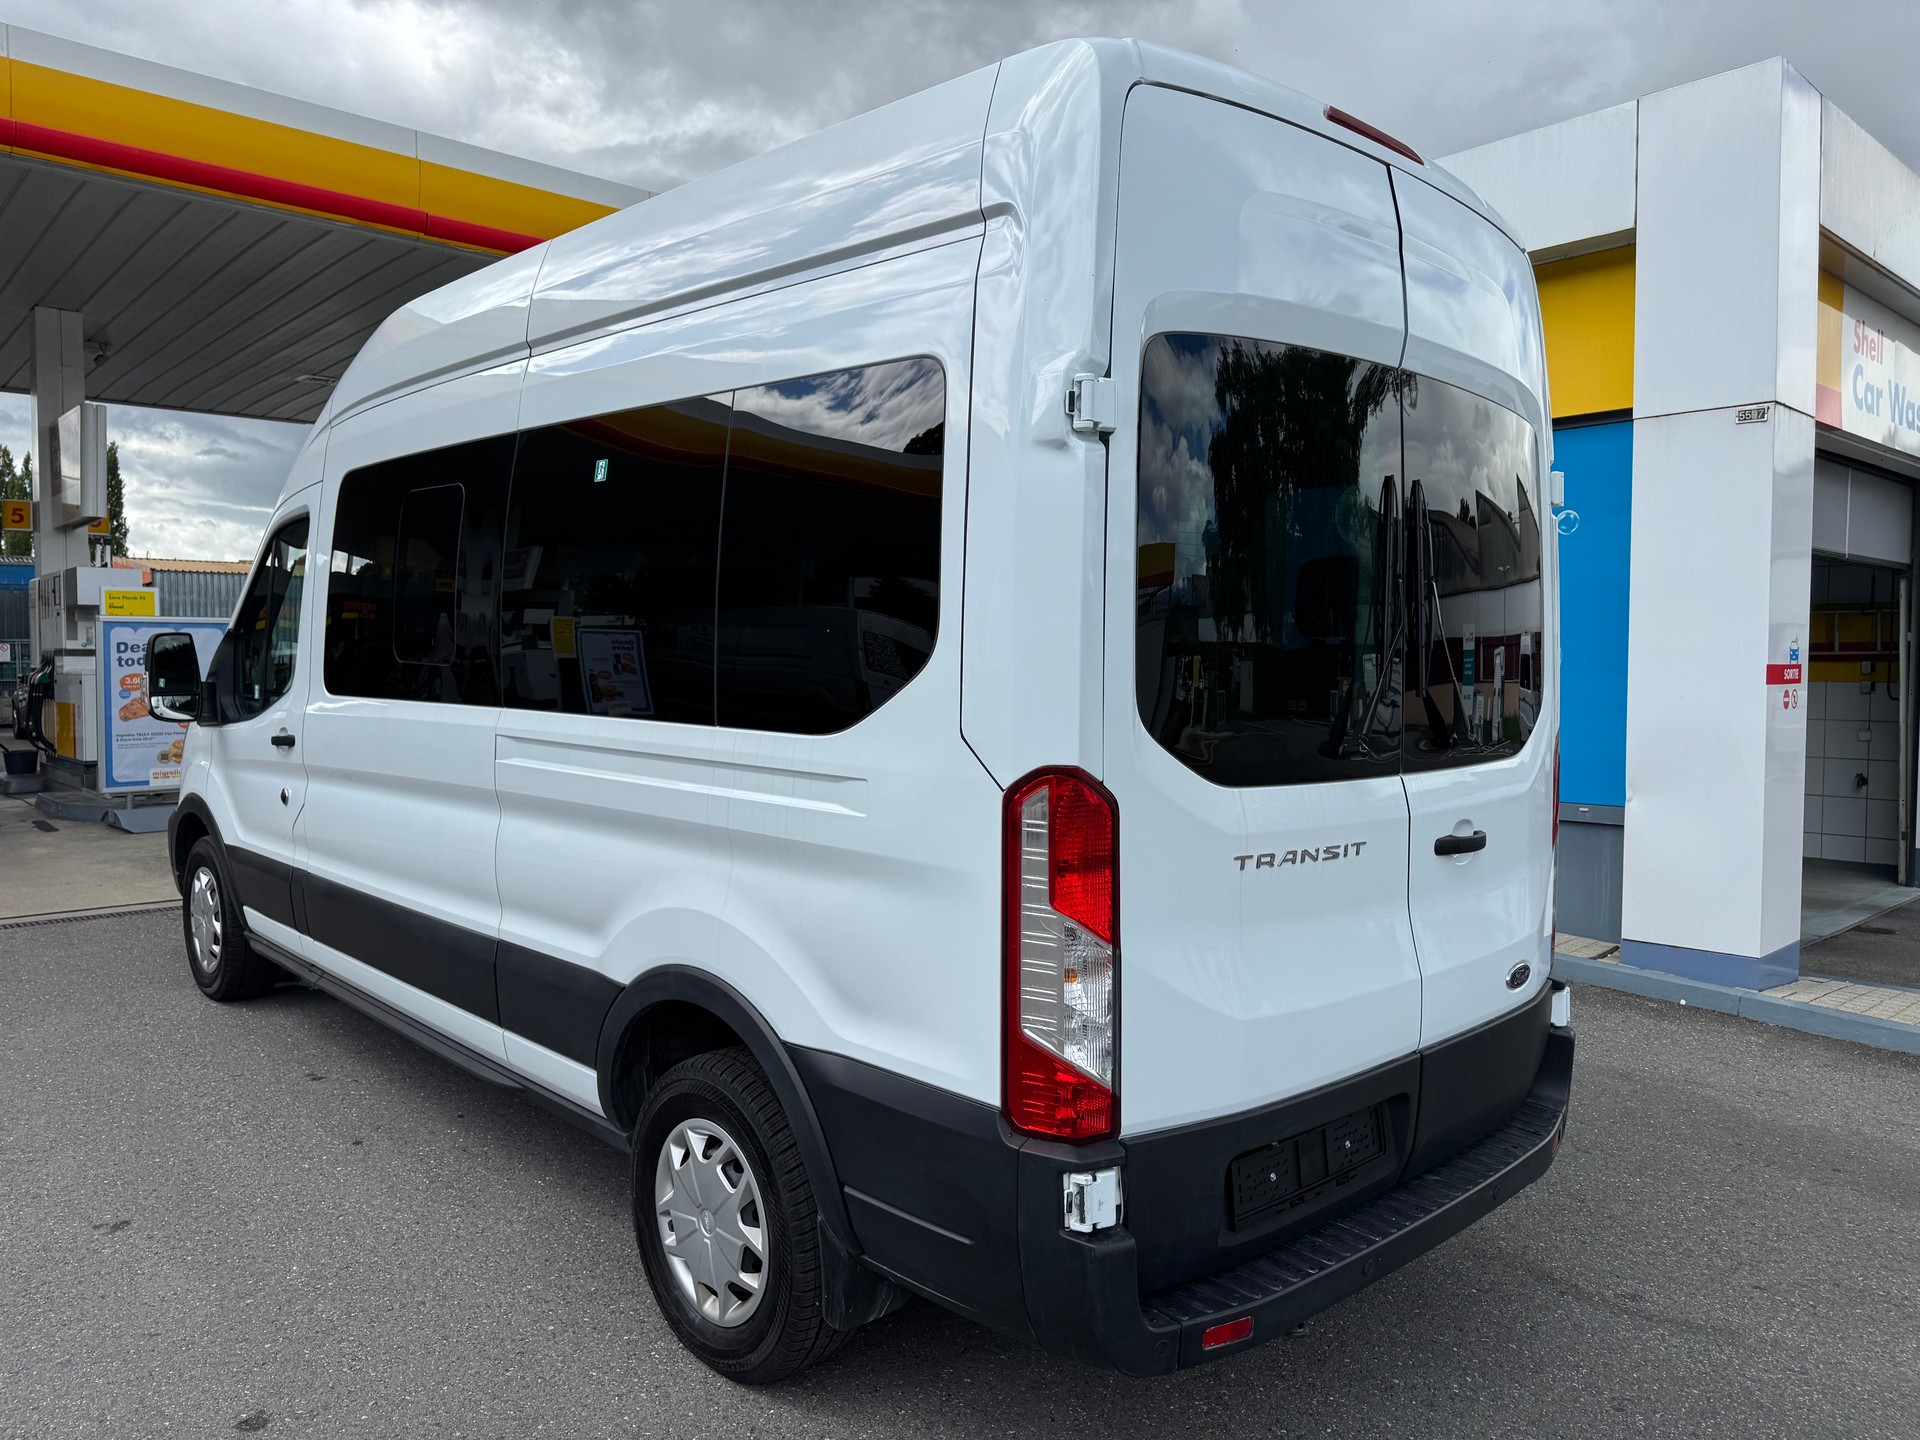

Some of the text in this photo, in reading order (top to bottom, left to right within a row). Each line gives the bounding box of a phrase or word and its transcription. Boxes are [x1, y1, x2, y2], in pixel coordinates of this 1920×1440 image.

[1853, 320, 1884, 365] Shell
[1852, 363, 1883, 417] Car
[11, 508, 24, 524] 5
[116, 641, 148, 654] Dea
[116, 655, 146, 667] tod
[1784, 668, 1798, 679] SORTIE
[1233, 841, 1367, 871] TRANSIT
